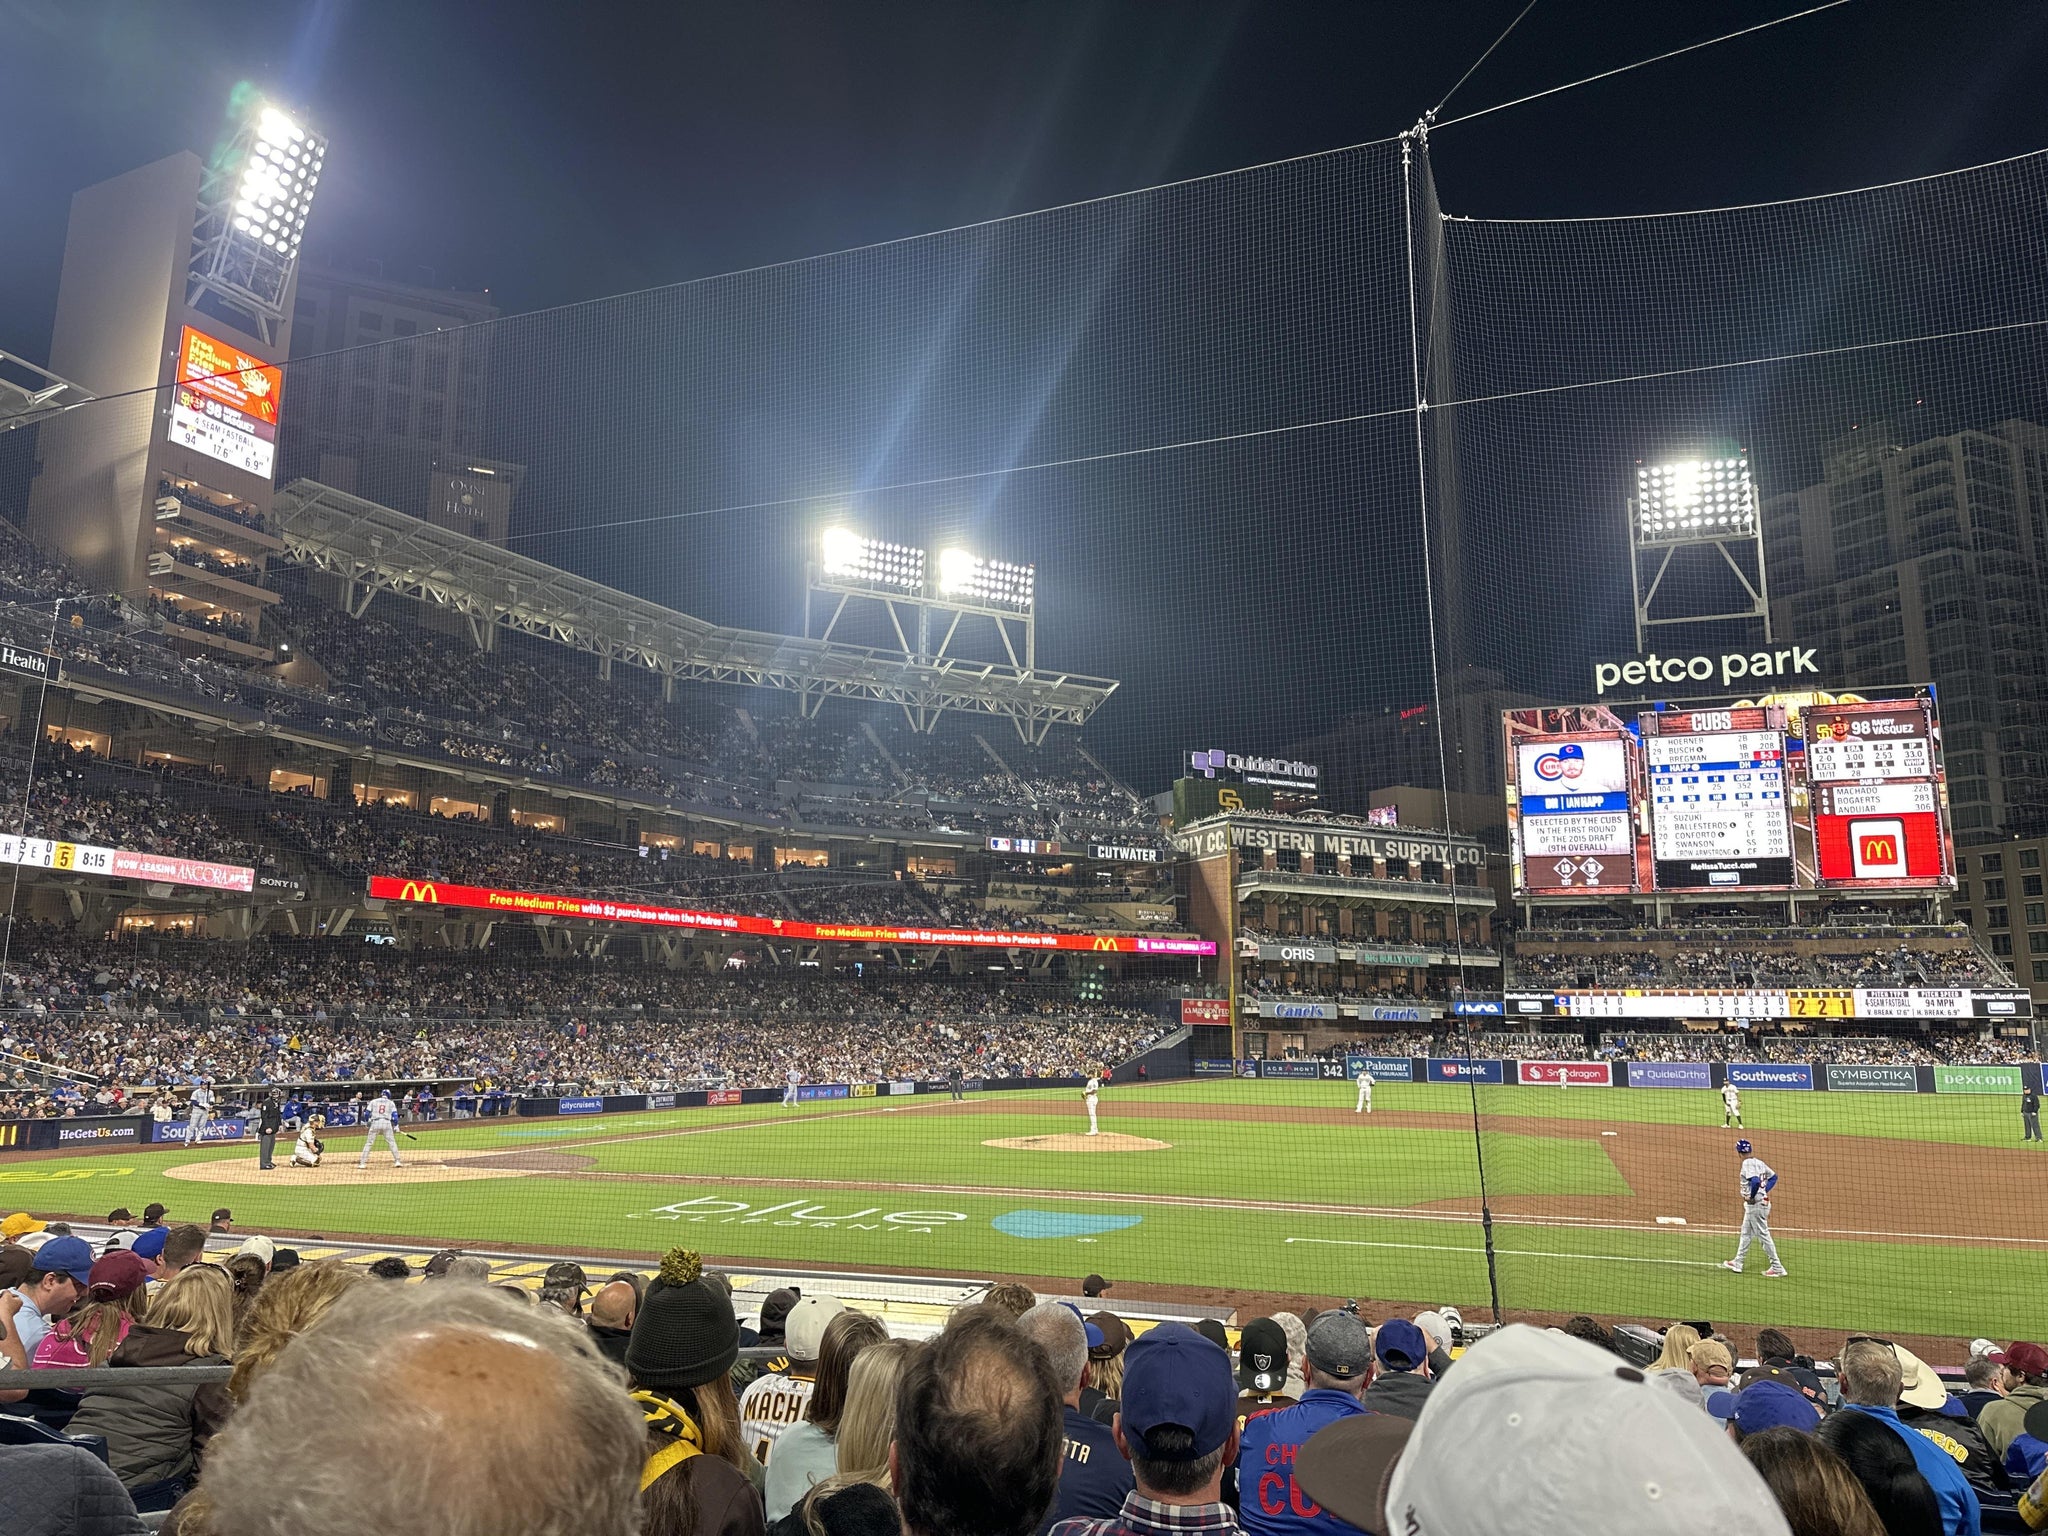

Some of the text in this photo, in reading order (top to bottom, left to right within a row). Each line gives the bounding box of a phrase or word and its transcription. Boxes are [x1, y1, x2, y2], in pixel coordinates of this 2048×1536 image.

[190, 334, 214, 352] Free
[188, 353, 214, 372] Fries
[190, 344, 232, 370] Medium
[206, 402, 222, 418] 98
[185, 433, 196, 445] 94
[2, 648, 46, 673] Health
[1595, 646, 1819, 694] petco park
[1691, 712, 1732, 731] CUBS
[1852, 721, 1870, 735] 98
[1227, 754, 1318, 777] QuidelOrtho
[1670, 764, 1690, 772] HAPP
[1836, 787, 1877, 795] MACHADO
[1566, 797, 1580, 808] IAN
[1580, 796, 1604, 808] HAPP
[1837, 796, 1880, 804] BOGAERTS
[1530, 818, 1569, 826] SELECTED
[1674, 822, 1728, 830] BALLESTEROS
[4, 838, 52, 858] H 5 E 0
[1098, 845, 1156, 861] CUTWATER
[1206, 827, 1484, 865] CO. WESTERN METAL SUPPLY CO.
[1548, 844, 1566, 852] (9TH
[44, 855, 50, 866] 0
[60, 852, 68, 866] 5
[82, 852, 105, 867] 8:15
[117, 859, 137, 870] NOW
[140, 861, 175, 874] LEASING
[178, 865, 226, 884] ANCORA
[1691, 862, 1757, 871] MelissaTucci.com
[260, 878, 288, 888] SONY
[490, 894, 738, 928] Free Medium Fries with $2 purchase when the Padres Win
[816, 928, 1057, 945] Free Medium Fries with purchase when the Padres Win
[1280, 947, 1315, 961] ORIS
[1797, 1000, 1847, 1015] 2 2 1
[1885, 999, 1911, 1007] FASTBALL
[1275, 1004, 1323, 1021] Canel's
[1372, 1007, 1418, 1021] Canel's
[1244, 1018, 1260, 1029] 336
[1324, 1065, 1343, 1076] 342
[1366, 1061, 1408, 1072] Palomar
[1442, 1064, 1486, 1075] us bank
[1547, 1068, 1600, 1081] Sndragon
[1647, 1069, 1706, 1080] QuidelOrtho
[1733, 1072, 1798, 1083] Southwest
[1831, 1070, 1912, 1080] CYMBIOTIKA
[378, 1105, 386, 1114] 8
[562, 1101, 595, 1111] citycruises
[59, 1127, 134, 1141] HeGetsUs.com
[649, 1196, 968, 1226] blue
[626, 1212, 934, 1234] CALIFORNIA
[1265, 1443, 1304, 1465] CH
